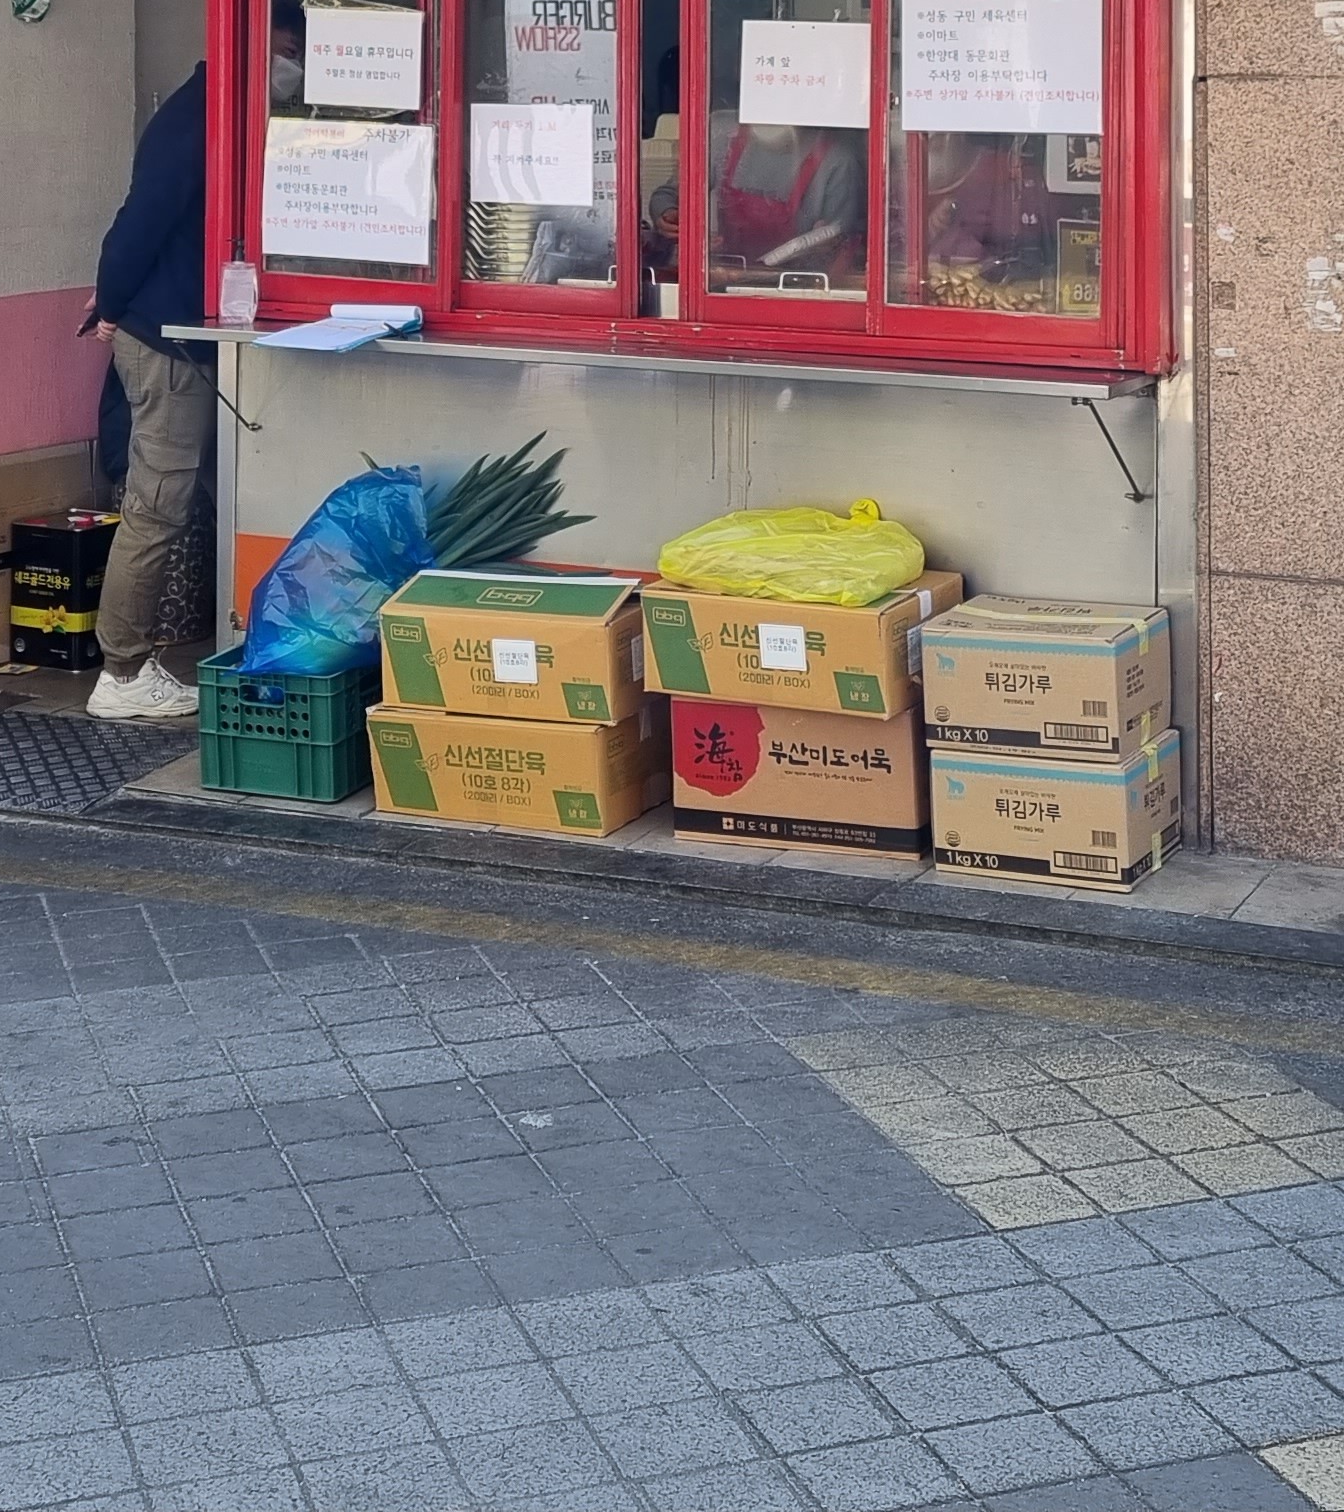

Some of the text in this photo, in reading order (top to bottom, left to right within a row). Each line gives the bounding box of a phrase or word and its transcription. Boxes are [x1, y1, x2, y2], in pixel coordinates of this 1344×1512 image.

[953, 9, 976, 23] 구민
[982, 9, 1028, 23] 체육센터
[313, 43, 414, 60] 매주 월요일 휴무입니다
[966, 49, 1010, 63] 동문회관
[755, 55, 791, 69] 가게 앞
[325, 67, 345, 79] 주말은
[365, 69, 401, 81] 영업합니다
[754, 73, 826, 87] 차량 주차 금지
[928, 68, 1048, 83] 주차장 이용부탁합니다
[974, 89, 1015, 102] 주차불가
[363, 128, 411, 144] 주차불가
[309, 148, 326, 159] 구민
[719, 622, 827, 658] 신선육
[452, 638, 555, 669] 신선육
[784, 675, 811, 690] BOX)
[984, 671, 1053, 695] 튀김가루
[975, 729, 989, 742] 10
[444, 744, 546, 776] 신선절단육
[768, 739, 893, 774] 부산미도어묵
[461, 772, 531, 794] (10호 8각)
[994, 798, 1062, 823] 튀김가루
[736, 820, 779, 834] 미도식품
[984, 855, 999, 869] 10
